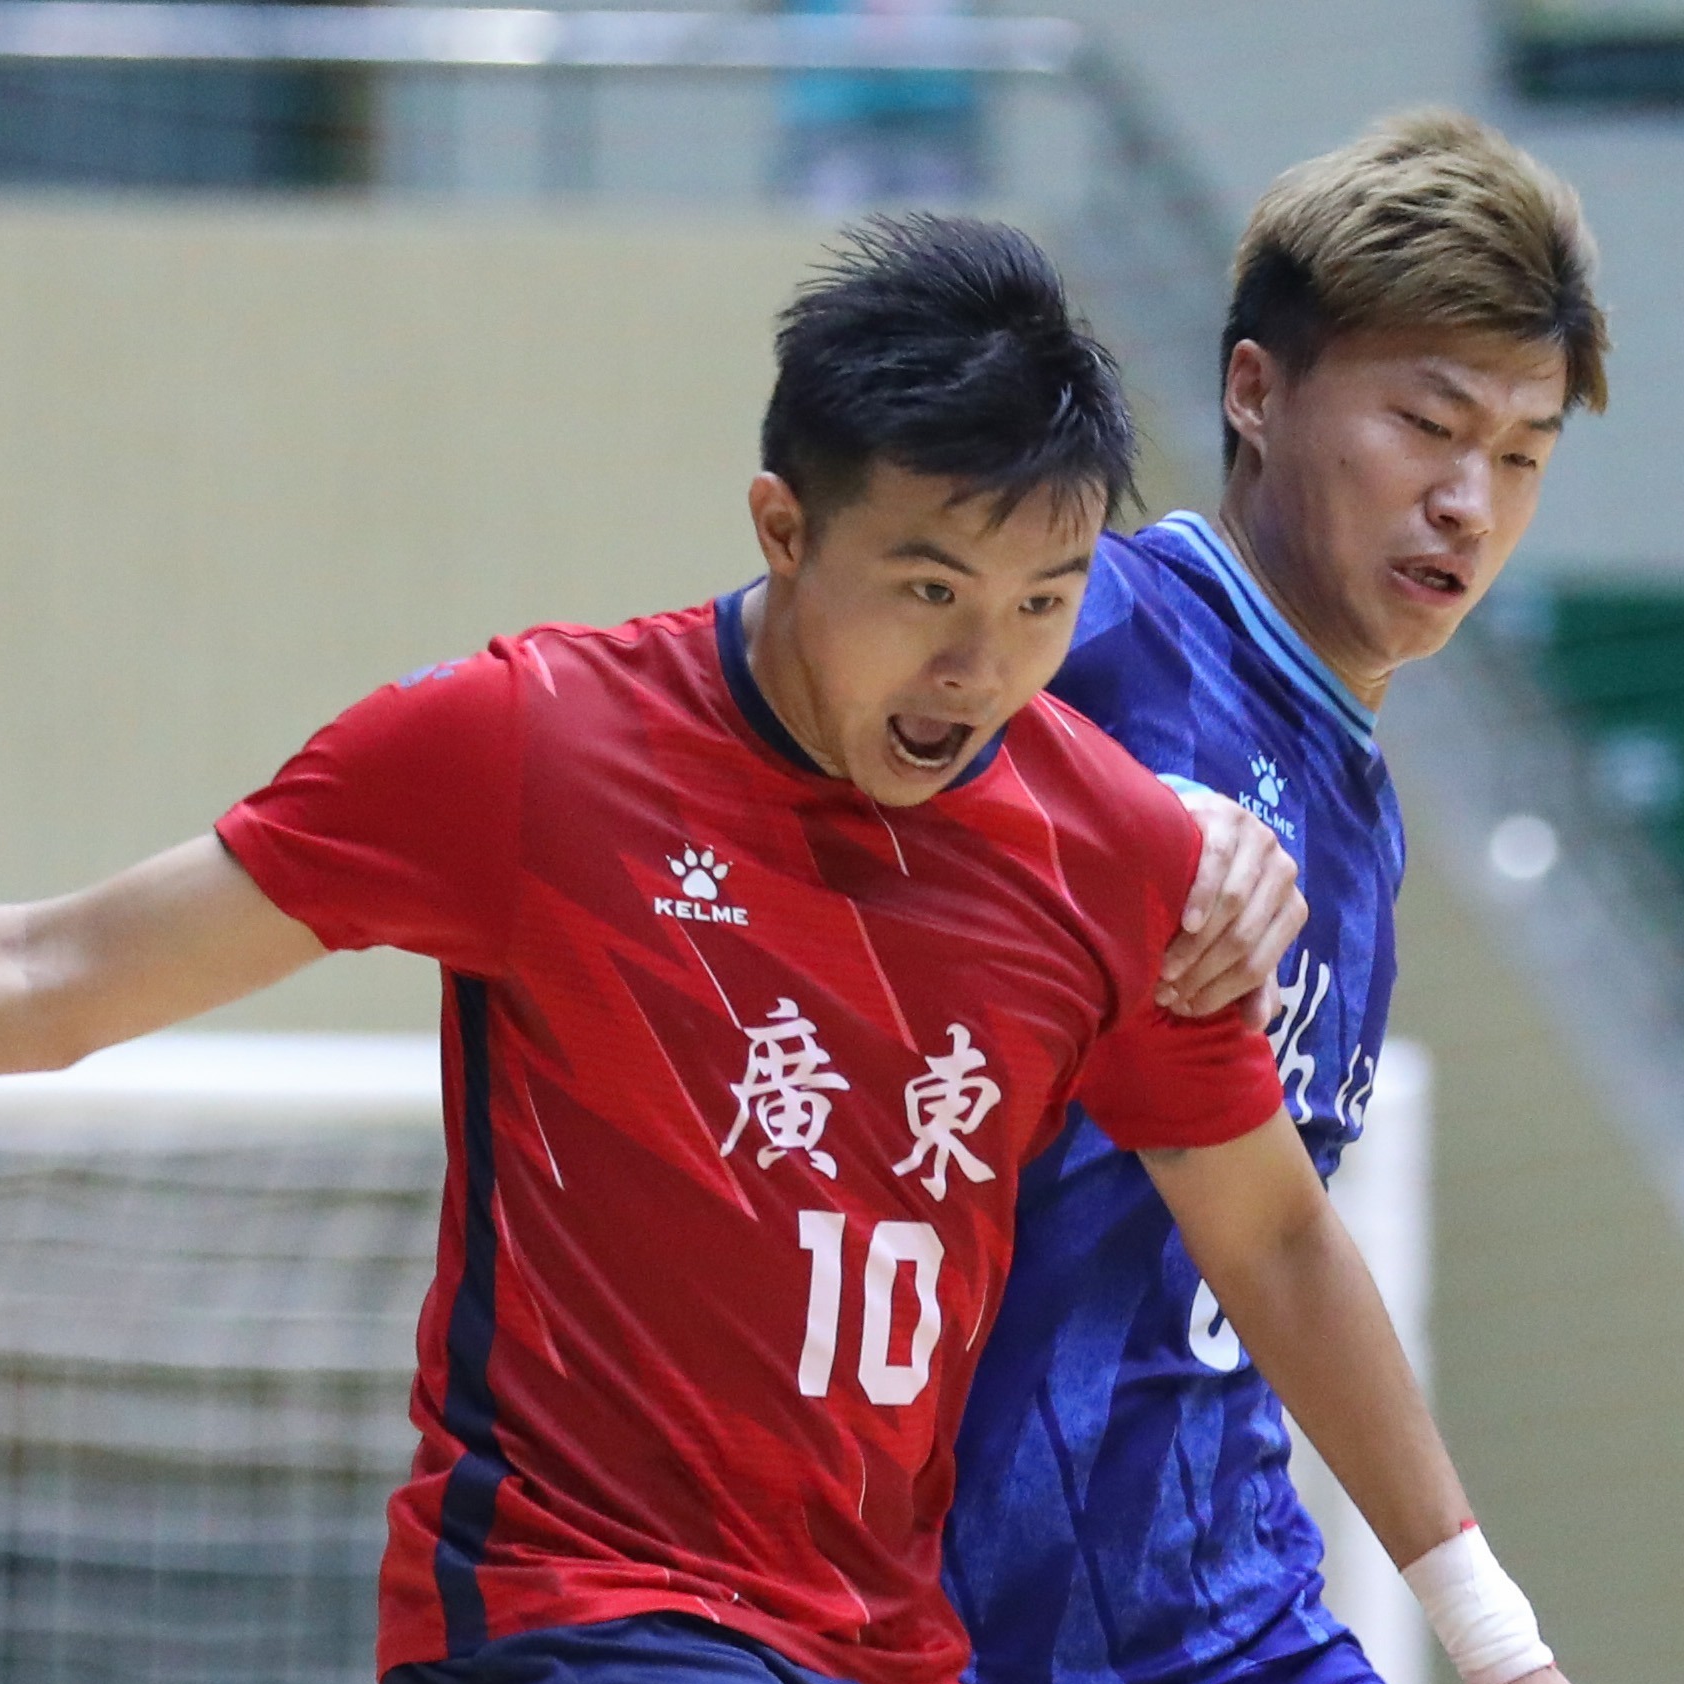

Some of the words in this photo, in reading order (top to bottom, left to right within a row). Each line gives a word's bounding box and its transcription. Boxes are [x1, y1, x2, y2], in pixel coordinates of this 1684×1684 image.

[1238, 791, 1296, 841] KELME
[654, 897, 750, 927] KELME
[720, 997, 1003, 1202] 廣東
[798, 1209, 945, 1406] 10
